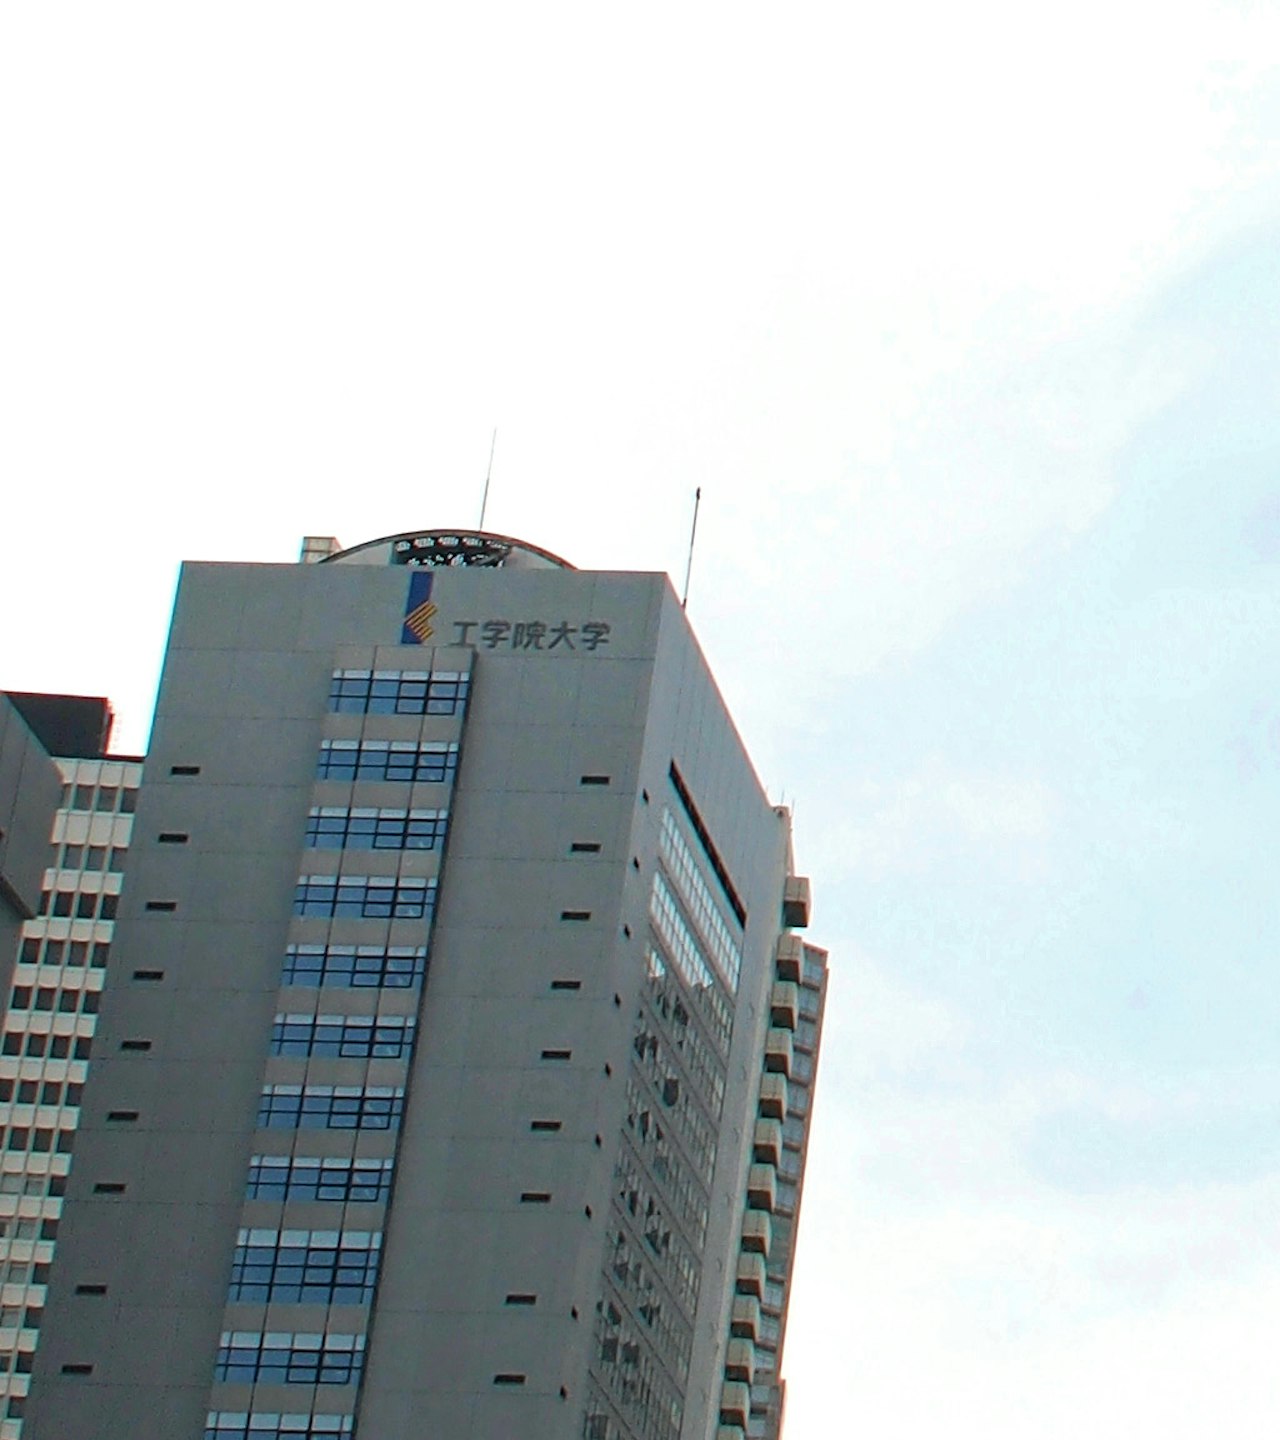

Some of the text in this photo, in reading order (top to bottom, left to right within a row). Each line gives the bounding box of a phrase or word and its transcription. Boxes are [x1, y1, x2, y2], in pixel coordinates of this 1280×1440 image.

[449, 620, 612, 651] 工学院大学
